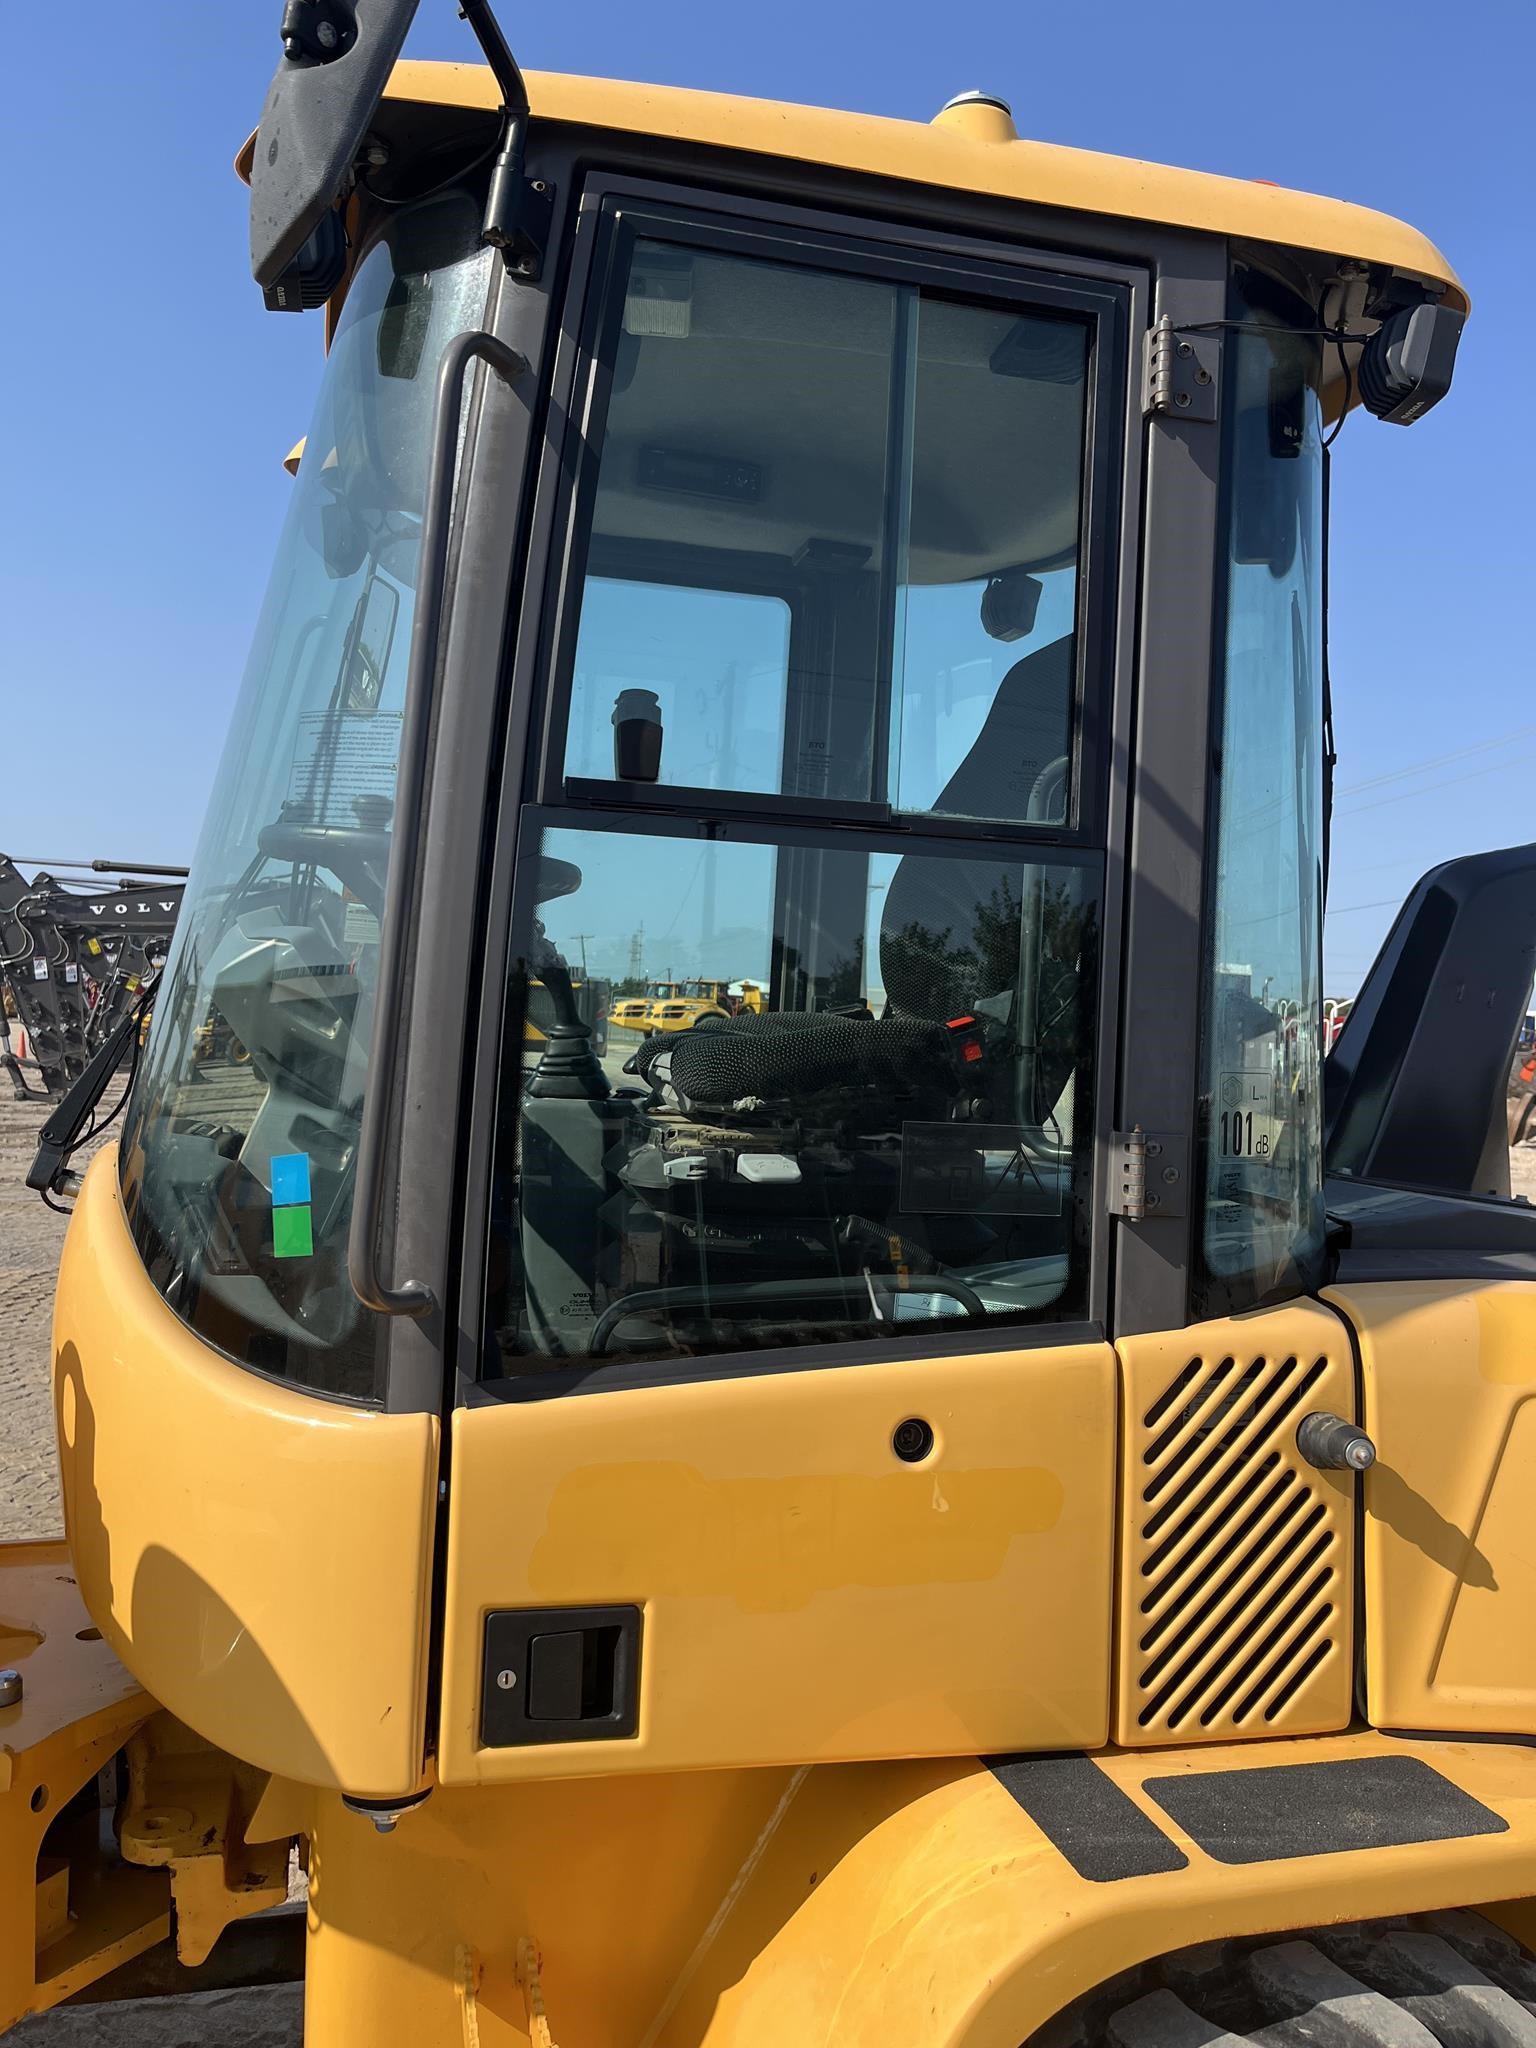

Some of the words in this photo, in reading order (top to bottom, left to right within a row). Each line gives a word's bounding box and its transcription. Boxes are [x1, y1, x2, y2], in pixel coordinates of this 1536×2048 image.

[89, 901, 175, 915] VOLV
[1221, 1110, 1253, 1156] 101
[1255, 1134, 1269, 1154] dB
